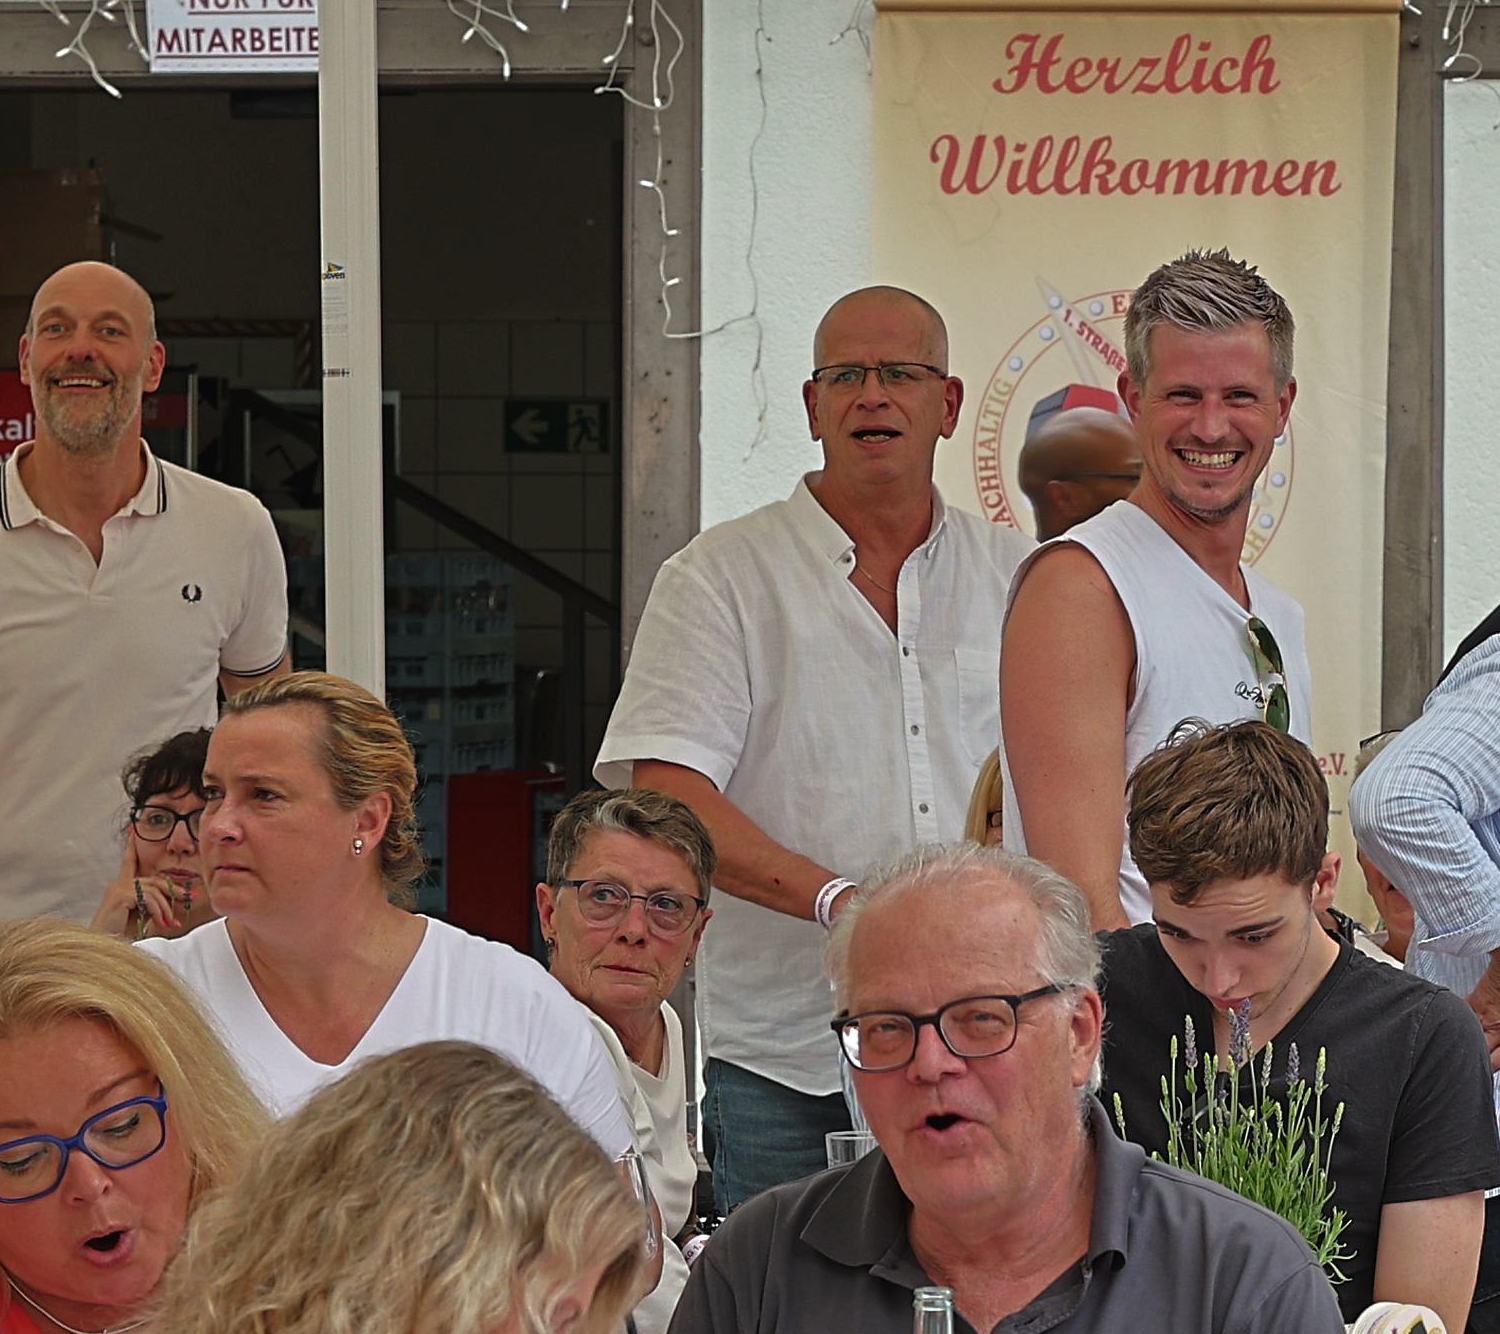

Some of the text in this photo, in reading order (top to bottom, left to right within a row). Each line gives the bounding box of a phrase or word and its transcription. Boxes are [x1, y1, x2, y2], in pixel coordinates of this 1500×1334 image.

[155, 25, 320, 55] MITARBEITE
[992, 32, 1282, 97] Herzlich
[928, 132, 1343, 198] Willkommen
[977, 378, 1014, 527] ACHHALTIG
